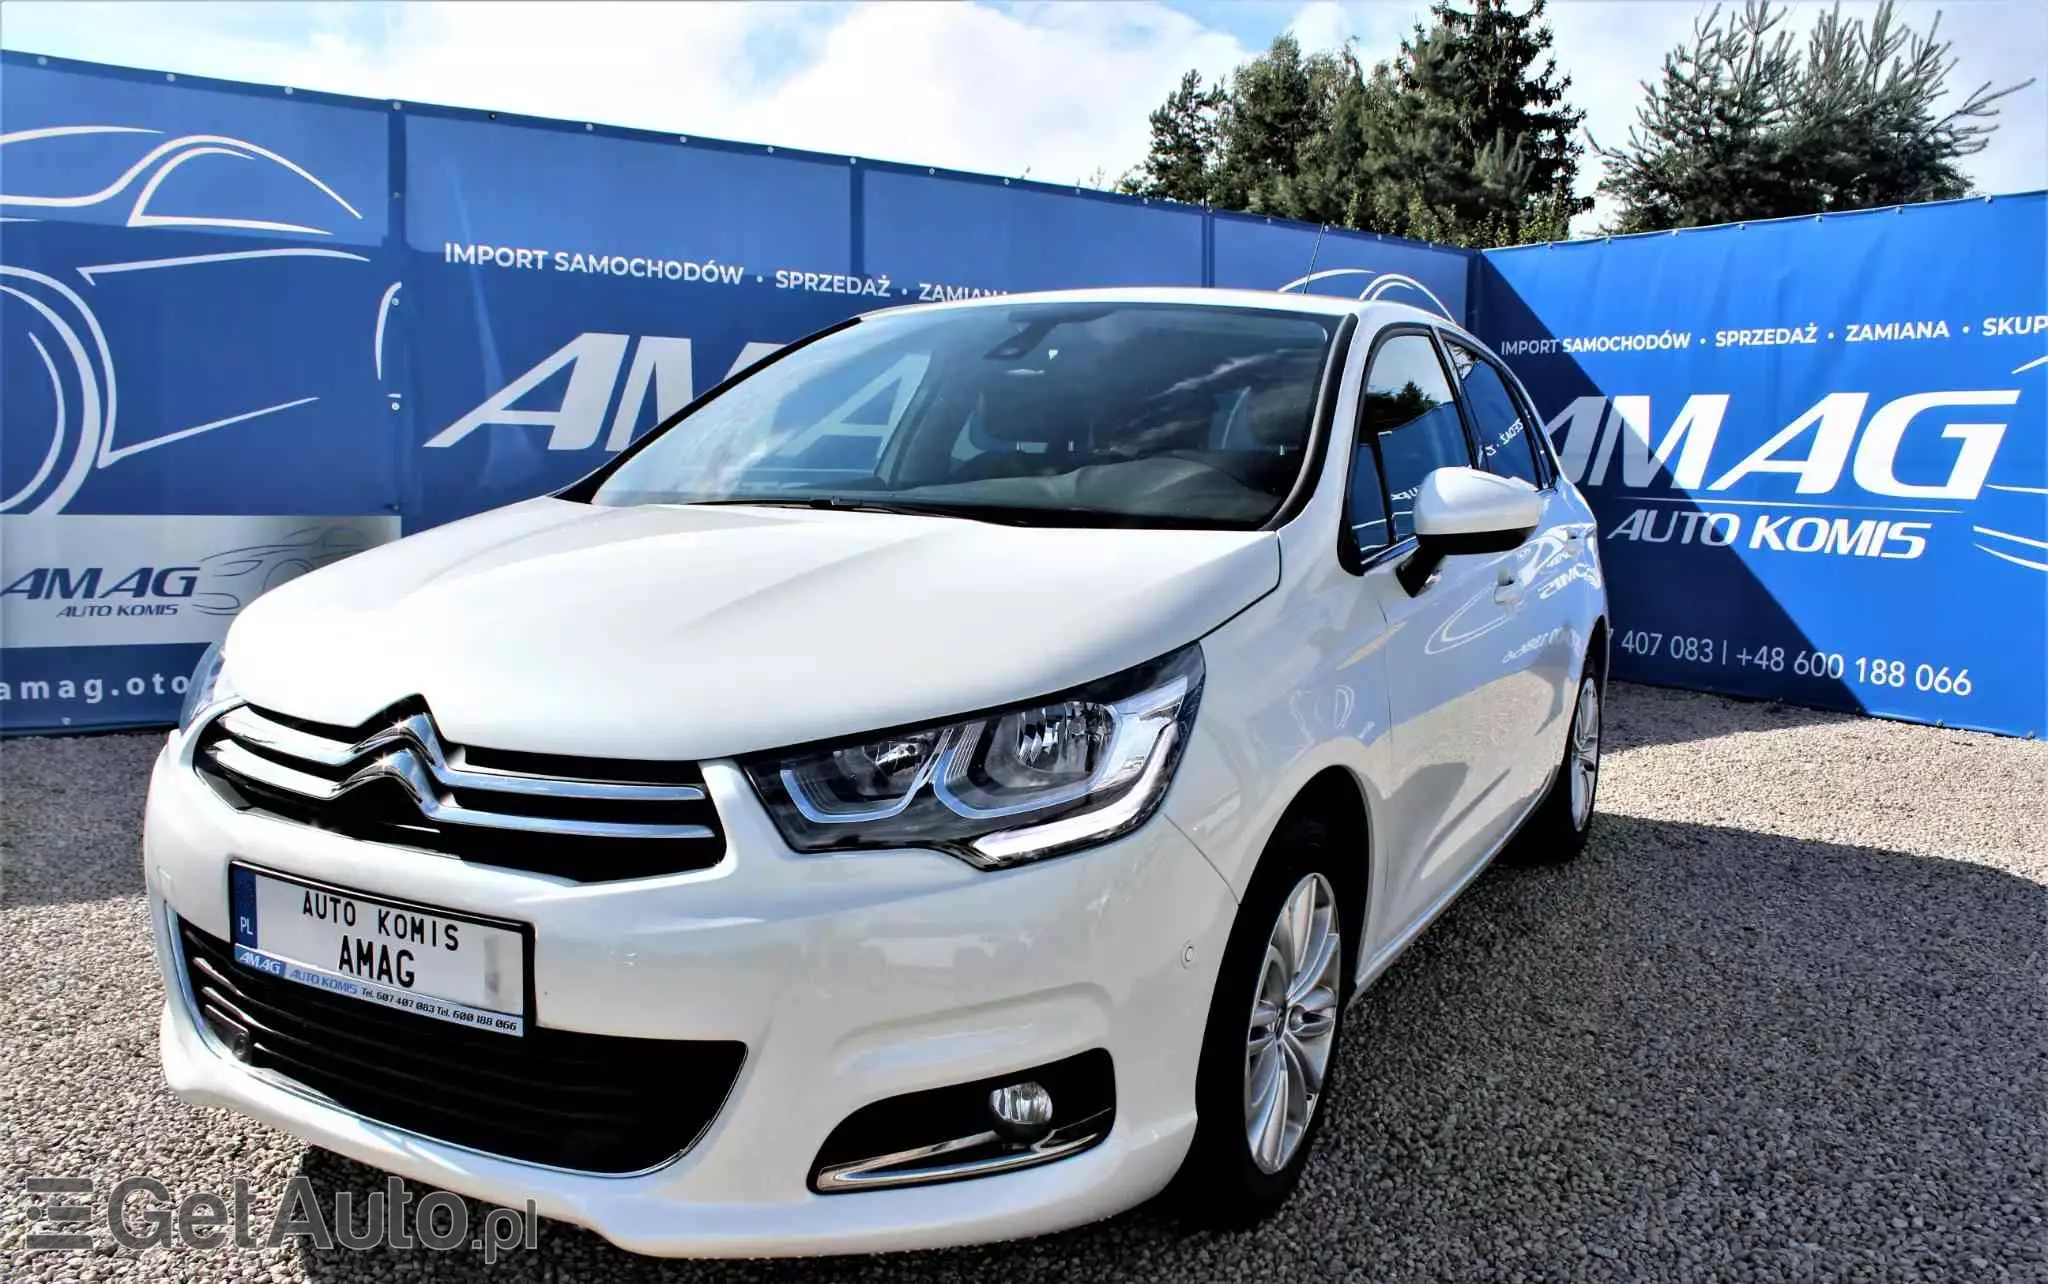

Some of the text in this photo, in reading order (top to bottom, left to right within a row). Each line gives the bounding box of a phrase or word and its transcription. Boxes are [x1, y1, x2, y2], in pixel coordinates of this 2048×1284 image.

[445, 243, 1007, 302] IMPORT SAMOCHODÓW SPRZEDAŻ ZAMIA
[1501, 315, 2048, 356] IMPORT SAMOCHODÓW SPRZEDAŻ ZAMIANA SKUP
[1546, 390, 2021, 500] AMAG
[1606, 508, 1932, 560] AUTO KOMIS
[0, 567, 200, 600] AMAG
[56, 603, 178, 618] AUTO KOMIS
[1621, 630, 1662, 656] 407
[1670, 635, 1713, 663] 083
[1736, 645, 1785, 672] +48
[1794, 650, 1844, 679] 600
[1855, 657, 1905, 687] 188
[1915, 664, 1972, 696] 066
[240, 915, 254, 936] PL
[303, 890, 459, 952] AUTO KOMIS
[338, 934, 415, 988] AMAG
[240, 951, 281, 975] AMAG
[290, 969, 321, 985] AUTO
[321, 976, 358, 995] KOMIS
[376, 991, 394, 1003] 607
[453, 1010, 475, 1023] 600
[477, 1014, 493, 1026] 188
